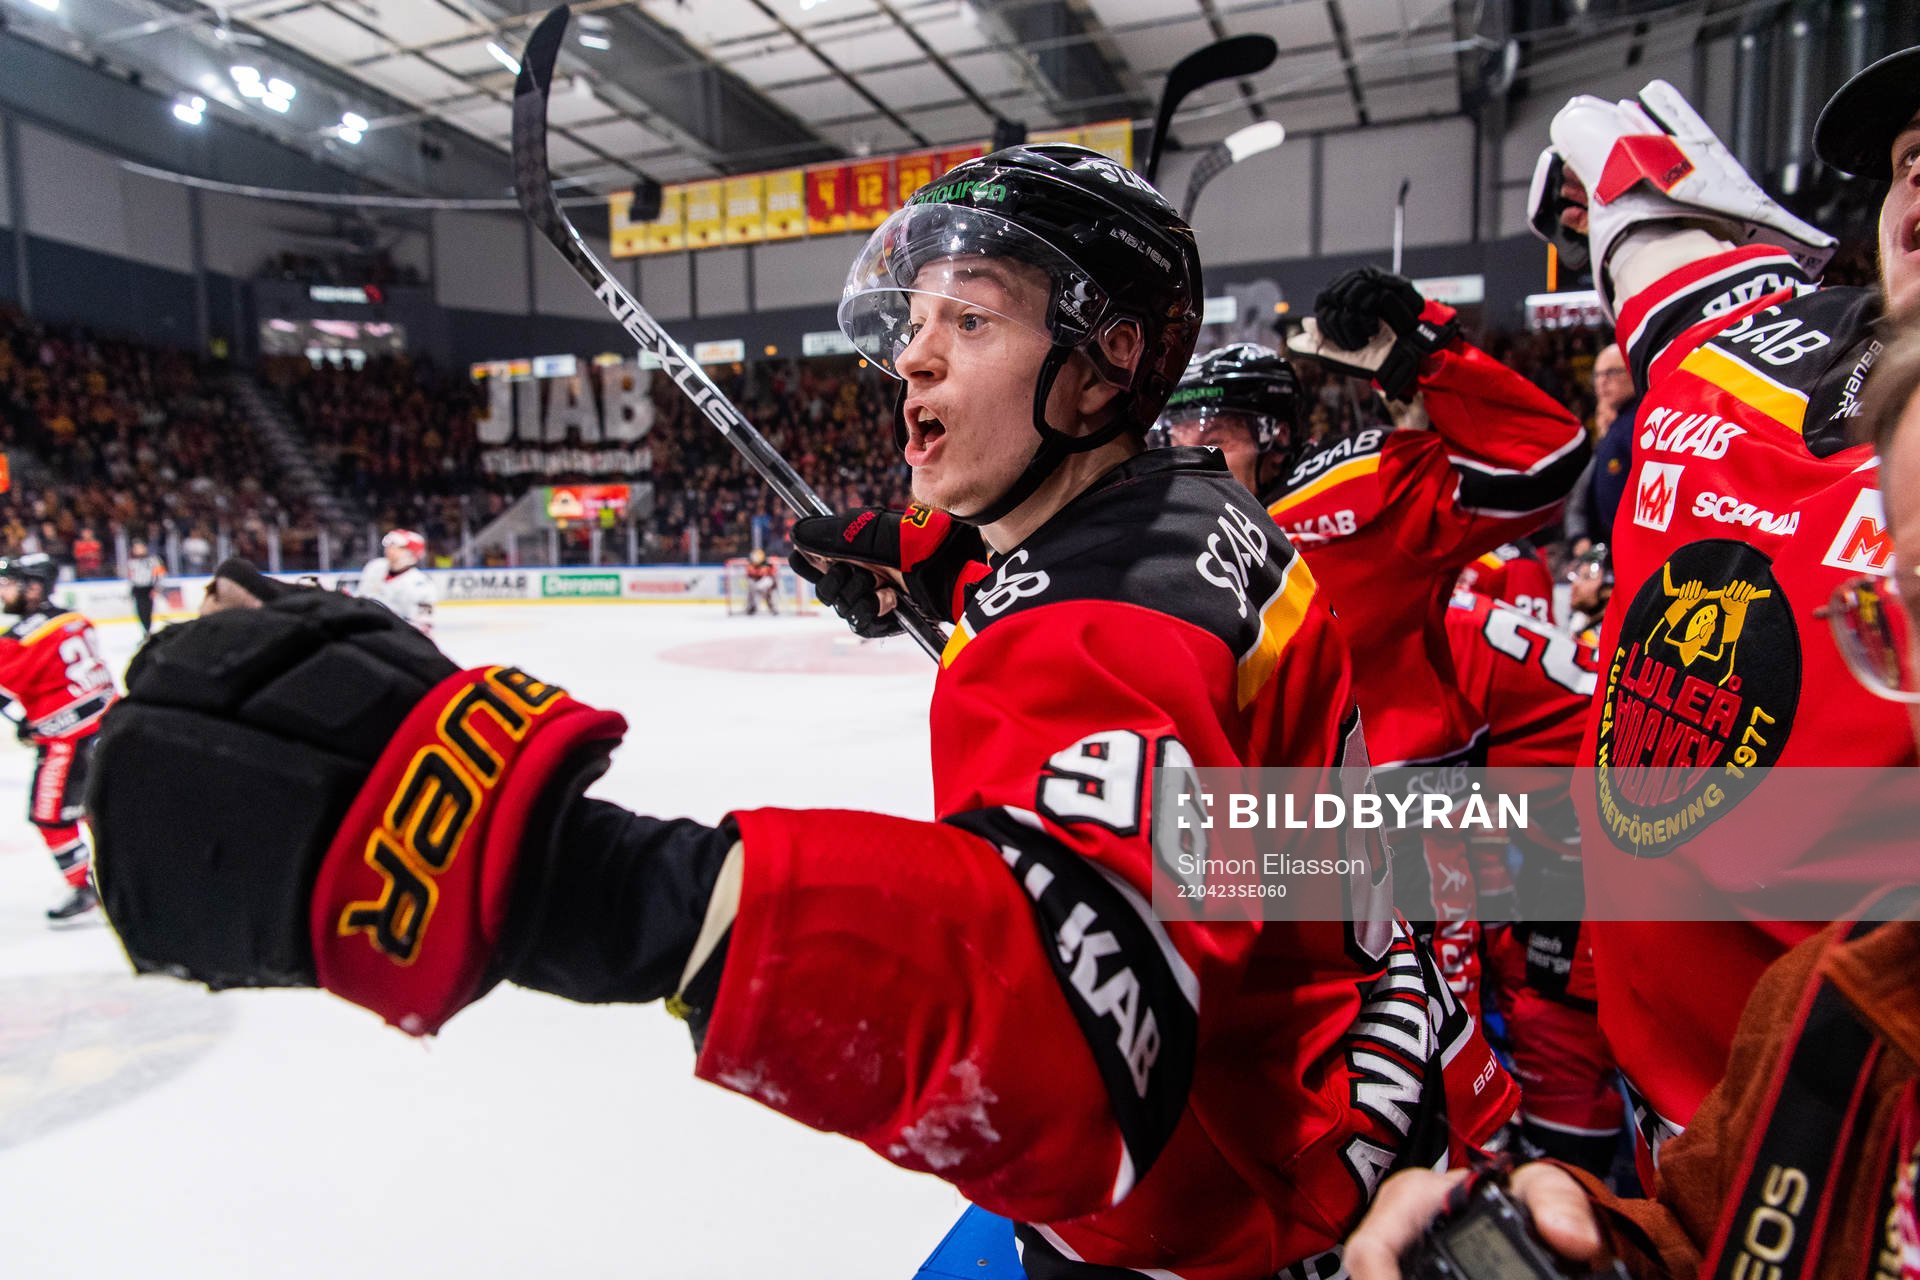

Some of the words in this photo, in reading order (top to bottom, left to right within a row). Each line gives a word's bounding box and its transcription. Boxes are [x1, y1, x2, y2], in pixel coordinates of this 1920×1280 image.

[857, 172, 883, 206] 12
[1059, 299, 1090, 329] BAUER
[595, 281, 739, 436] NEXUS
[1287, 430, 1383, 487] SSAB
[1196, 503, 1268, 619] SSAB
[1619, 641, 1744, 739] LULEÅ
[1611, 689, 1726, 807] HOCKEY
[1725, 705, 1776, 780] 1977
